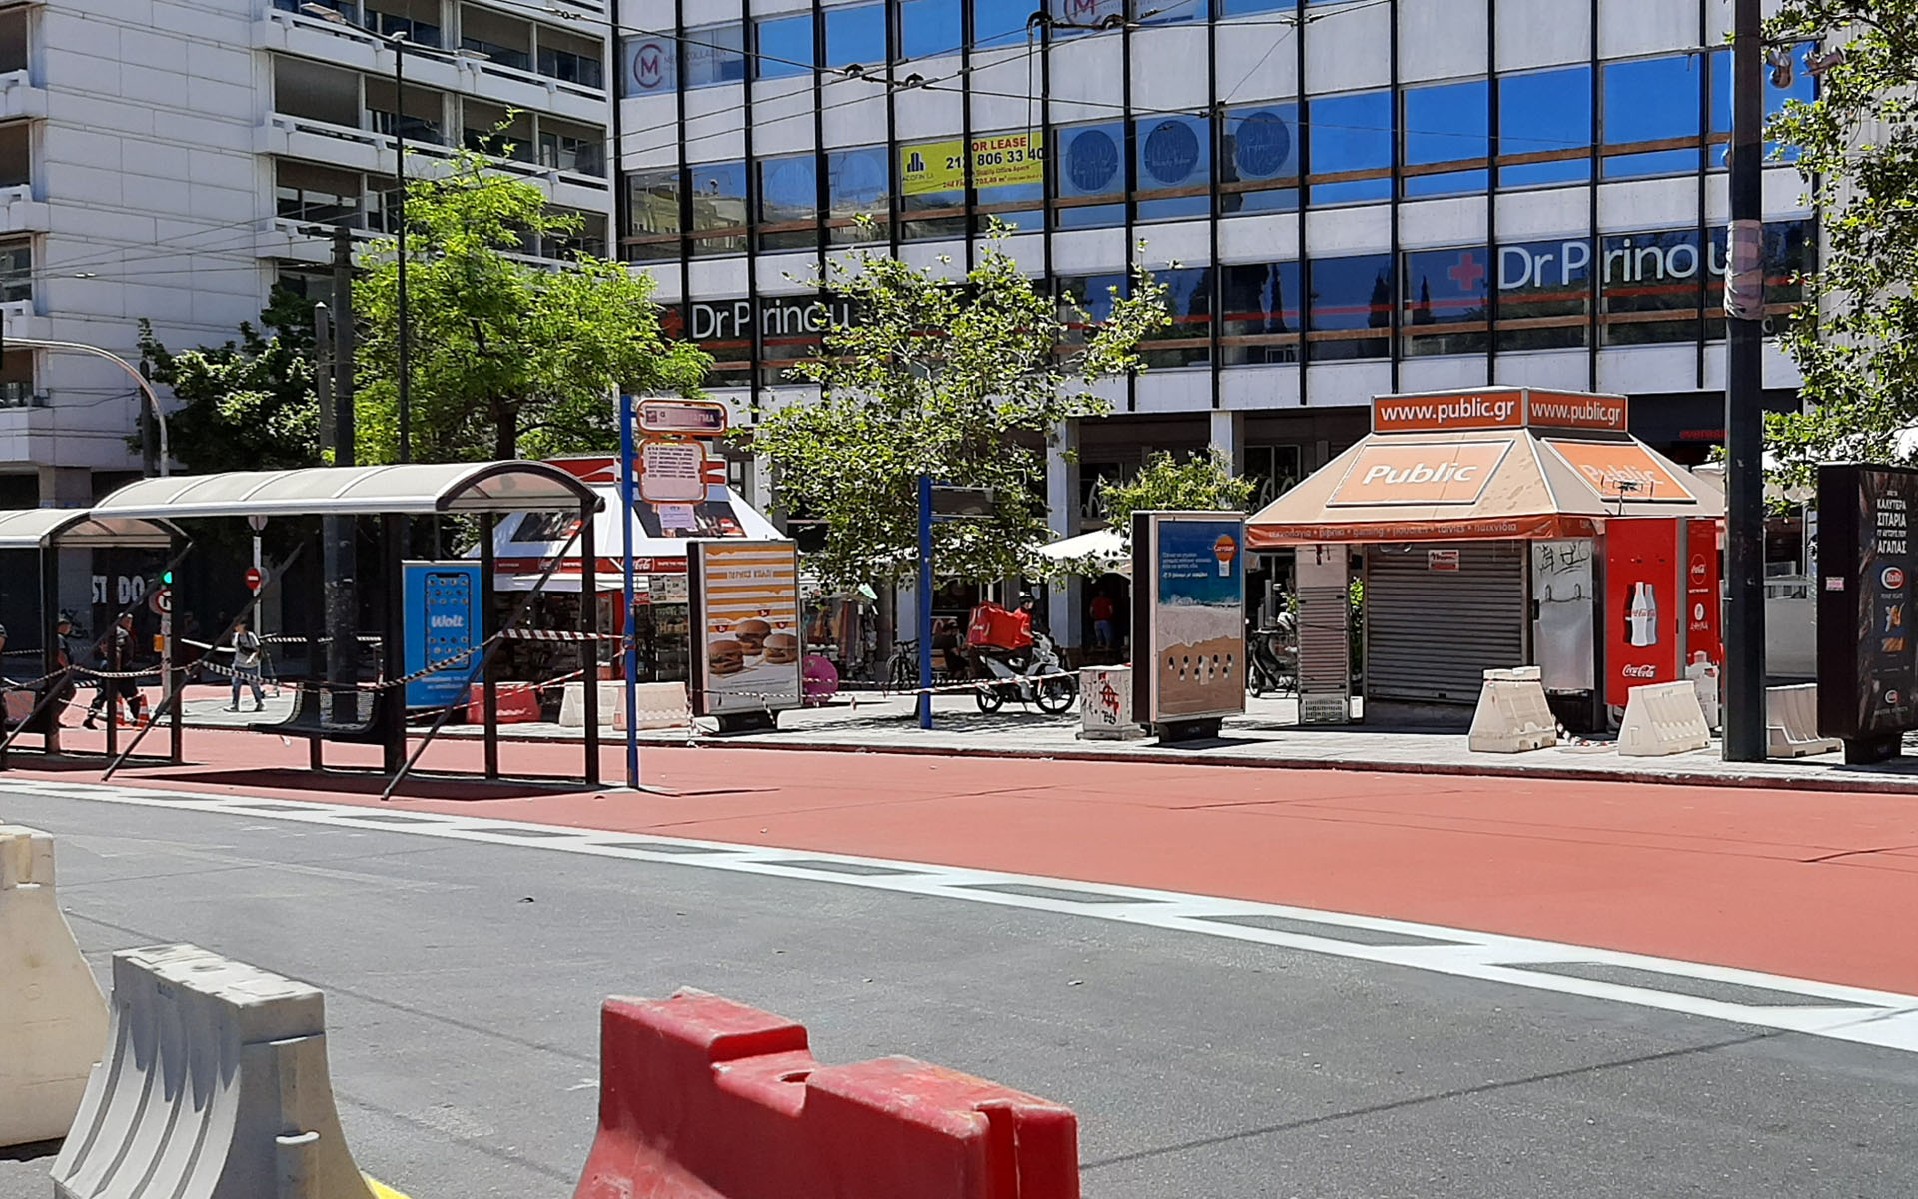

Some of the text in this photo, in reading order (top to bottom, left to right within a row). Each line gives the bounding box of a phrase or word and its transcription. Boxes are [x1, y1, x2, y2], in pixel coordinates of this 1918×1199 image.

[971, 136, 1027, 152] OR LEASE
[945, 156, 965, 170] 21
[977, 152, 1003, 166] 806
[1007, 149, 1024, 163] 33
[1498, 246, 1553, 290] Dr
[691, 303, 729, 339] Dr
[1381, 398, 1515, 423] www.public.gr
[1531, 401, 1622, 426] www.public.gr
[1362, 462, 1477, 485] Public
[1579, 464, 1664, 485] Public
[1876, 498, 1907, 511] ΚΑΛΥΤΕΡΑ
[1876, 512, 1907, 527] ΣΙΤΑΡΙΑ
[1876, 540, 1907, 554] ΑΓΑΠΑΣ
[118, 575, 145, 605] DO
[431, 614, 465, 628] Wolt
